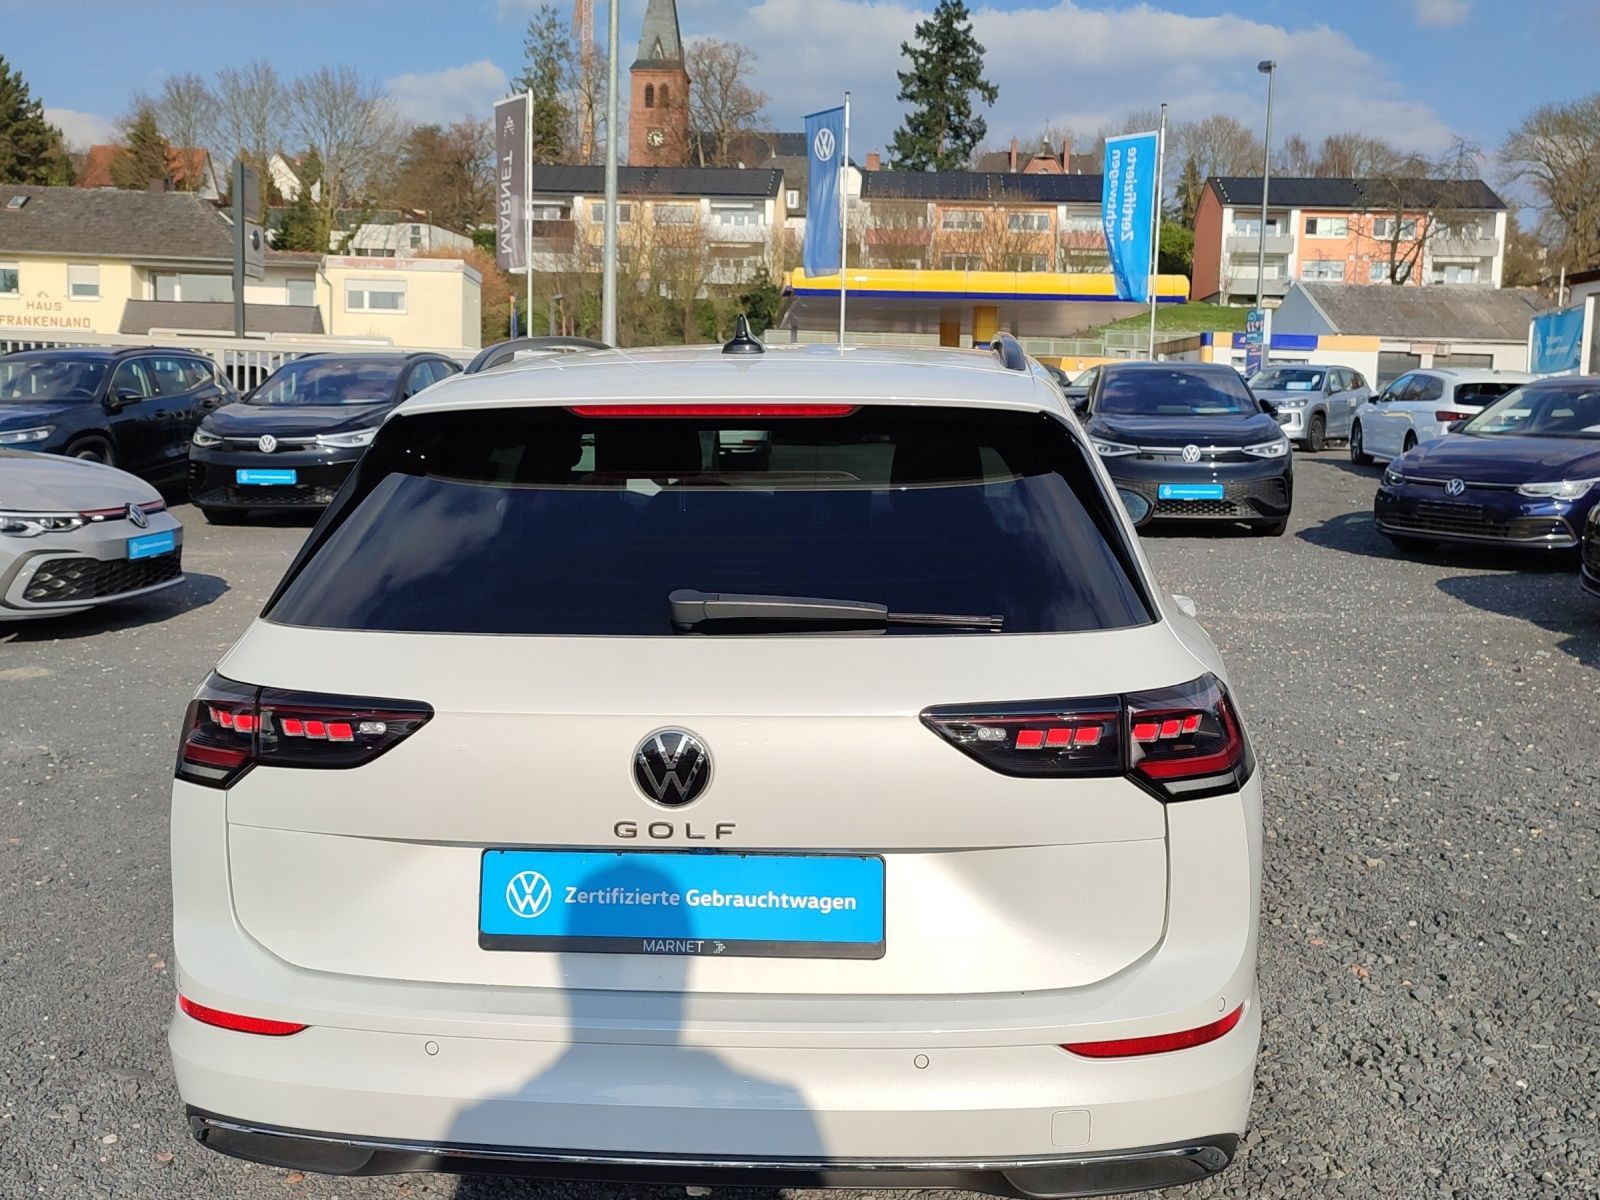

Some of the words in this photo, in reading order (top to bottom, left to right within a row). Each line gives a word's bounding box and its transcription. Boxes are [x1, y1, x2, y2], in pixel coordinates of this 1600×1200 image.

[26, 301, 63, 312] HAUS
[0, 315, 92, 329] FRANKENLAND
[613, 820, 737, 840] GOLF
[564, 886, 680, 907] Zertifizierte
[685, 890, 857, 914] Gebrauchtwagen
[642, 939, 705, 954] MARNET
